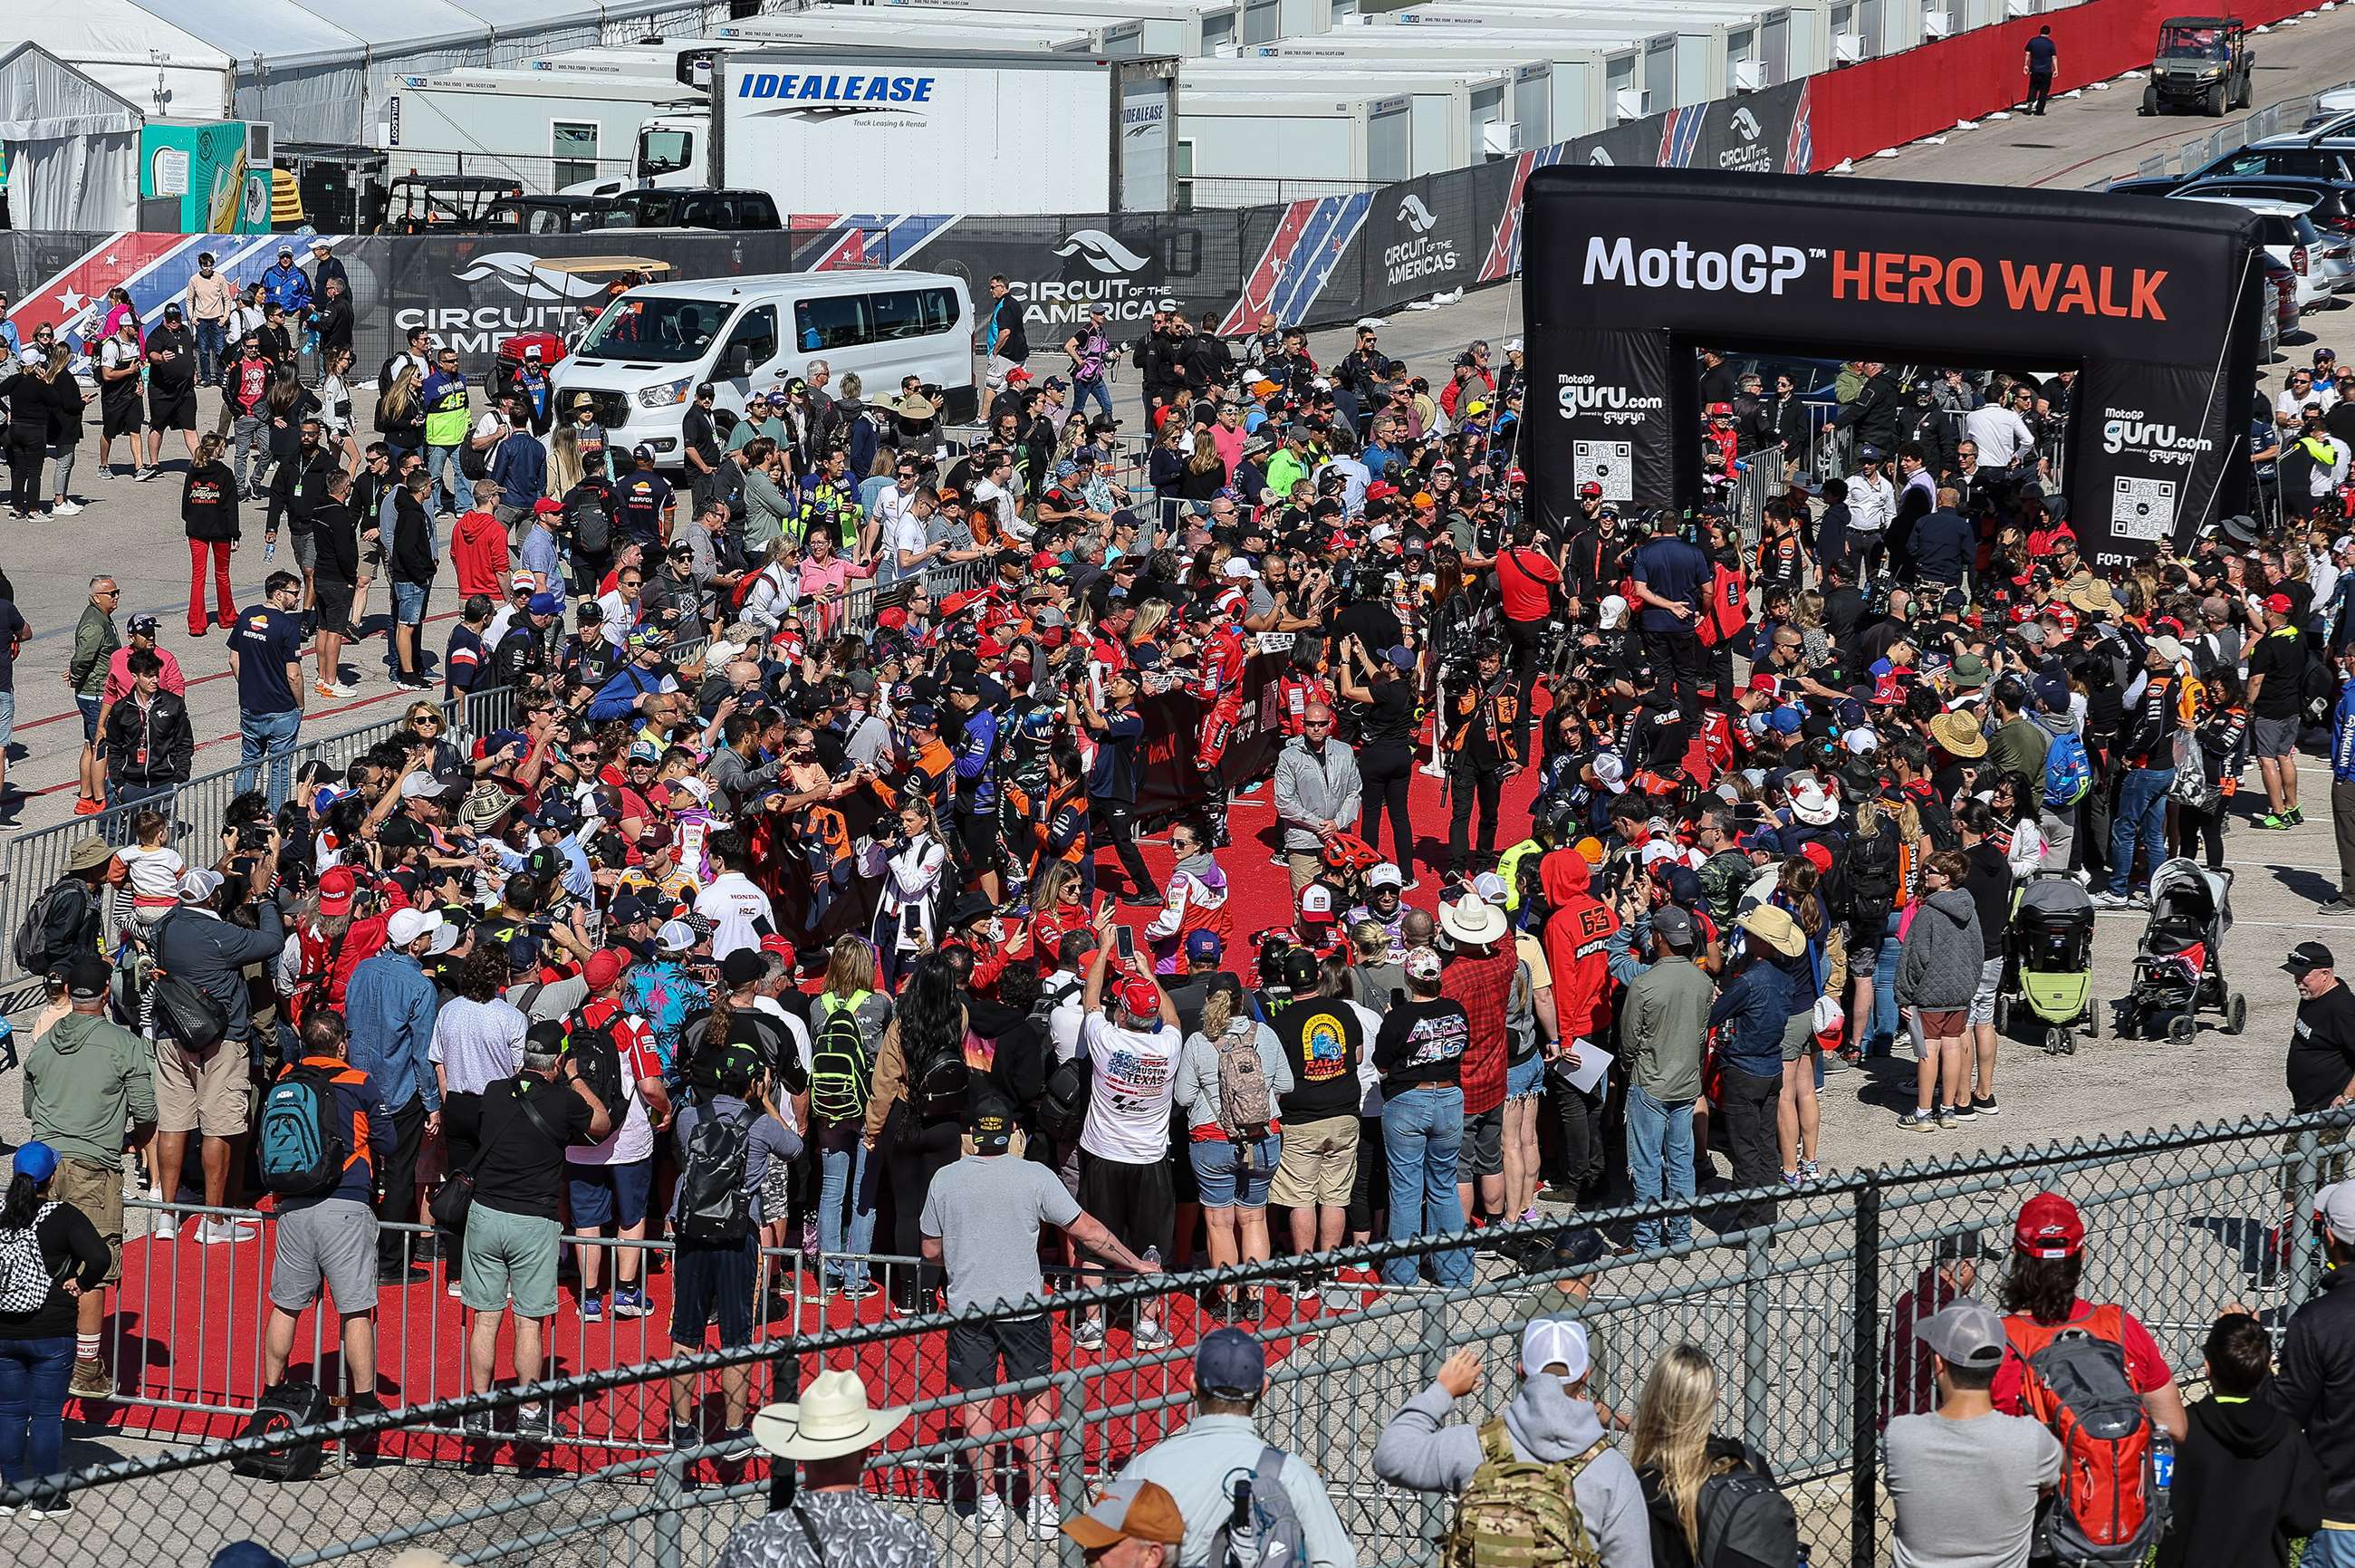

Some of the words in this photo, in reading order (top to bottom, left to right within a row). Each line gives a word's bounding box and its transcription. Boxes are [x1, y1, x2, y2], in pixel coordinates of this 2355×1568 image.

[738, 73, 936, 101] IDEALEASE
[390, 97, 399, 144] WILLSCOT
[853, 119, 871, 128] Truck
[872, 120, 899, 130] Leasing
[899, 120, 905, 129] &
[906, 120, 928, 130] Rental
[1123, 104, 1164, 124] IDEALEASE
[1719, 143, 1757, 168] CIRCUIT
[1384, 236, 1428, 267] CIRCUIT
[1427, 244, 1436, 253] OF
[1436, 239, 1453, 250] THE
[1008, 279, 1130, 302] CIRCUIT
[1129, 287, 1143, 297] OF
[1147, 285, 1172, 296] THE
[1832, 249, 1984, 307] HERO
[1999, 259, 2169, 321] WALK
[394, 306, 578, 332] CIRCUIT
[1558, 373, 1596, 384] MotoGP
[1558, 385, 1663, 419] guru.com
[2104, 407, 2145, 420] MotoGP
[2102, 419, 2213, 455] guru.com
[629, 495, 653, 504] REPSOL
[2096, 552, 2123, 567] FOR
[242, 630, 267, 642] REPSOL
[896, 684, 913, 697] 12
[2339, 727, 2355, 768] MAGELLAN
[1908, 843, 1918, 871] RACE
[322, 890, 346, 899] DUCATI
[738, 908, 757, 916] HRC
[1577, 905, 1611, 939] 63
[1127, 1072, 1166, 1085] TEXAS
[1138, 1066, 1167, 1077] AUSTIN
